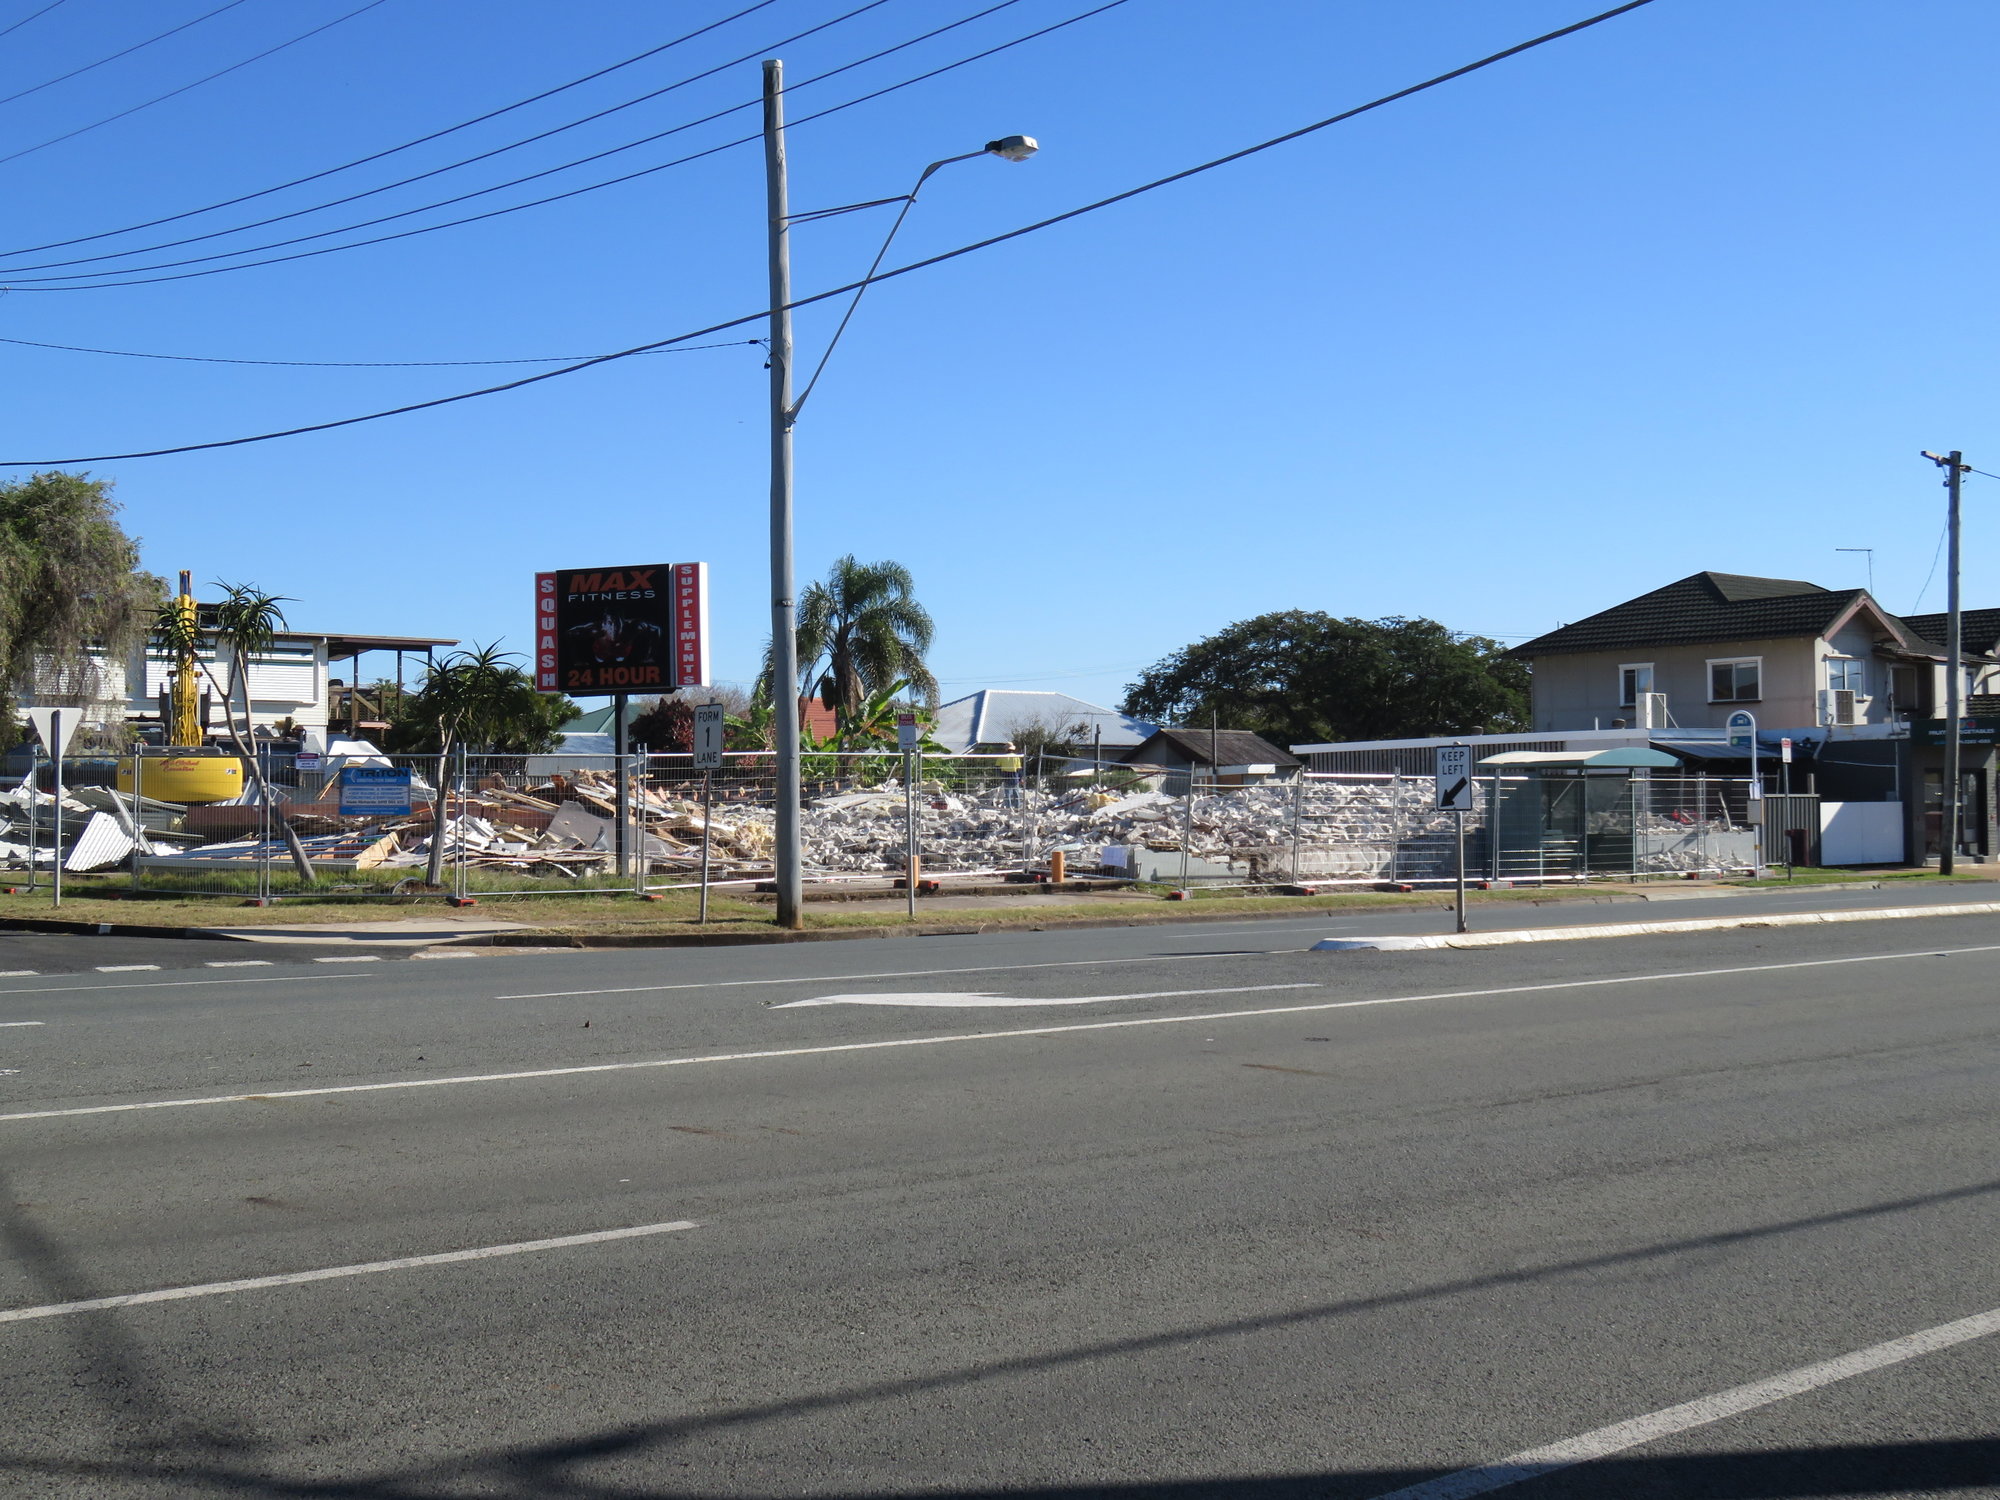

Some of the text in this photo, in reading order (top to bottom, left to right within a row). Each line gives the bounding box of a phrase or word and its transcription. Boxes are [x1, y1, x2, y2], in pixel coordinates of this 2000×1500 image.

[569, 569, 657, 593] MAX
[568, 590, 656, 603] FITNESS
[541, 579, 556, 687] SQUASH
[680, 565, 696, 684] SUPPLEMENTS
[568, 666, 662, 687] 24 HOUR
[698, 710, 719, 722] FORM
[705, 726, 710, 748] 1
[696, 751, 717, 763] LANE
[1441, 751, 1465, 761] KEEP
[1442, 764, 1464, 775] LEFT
